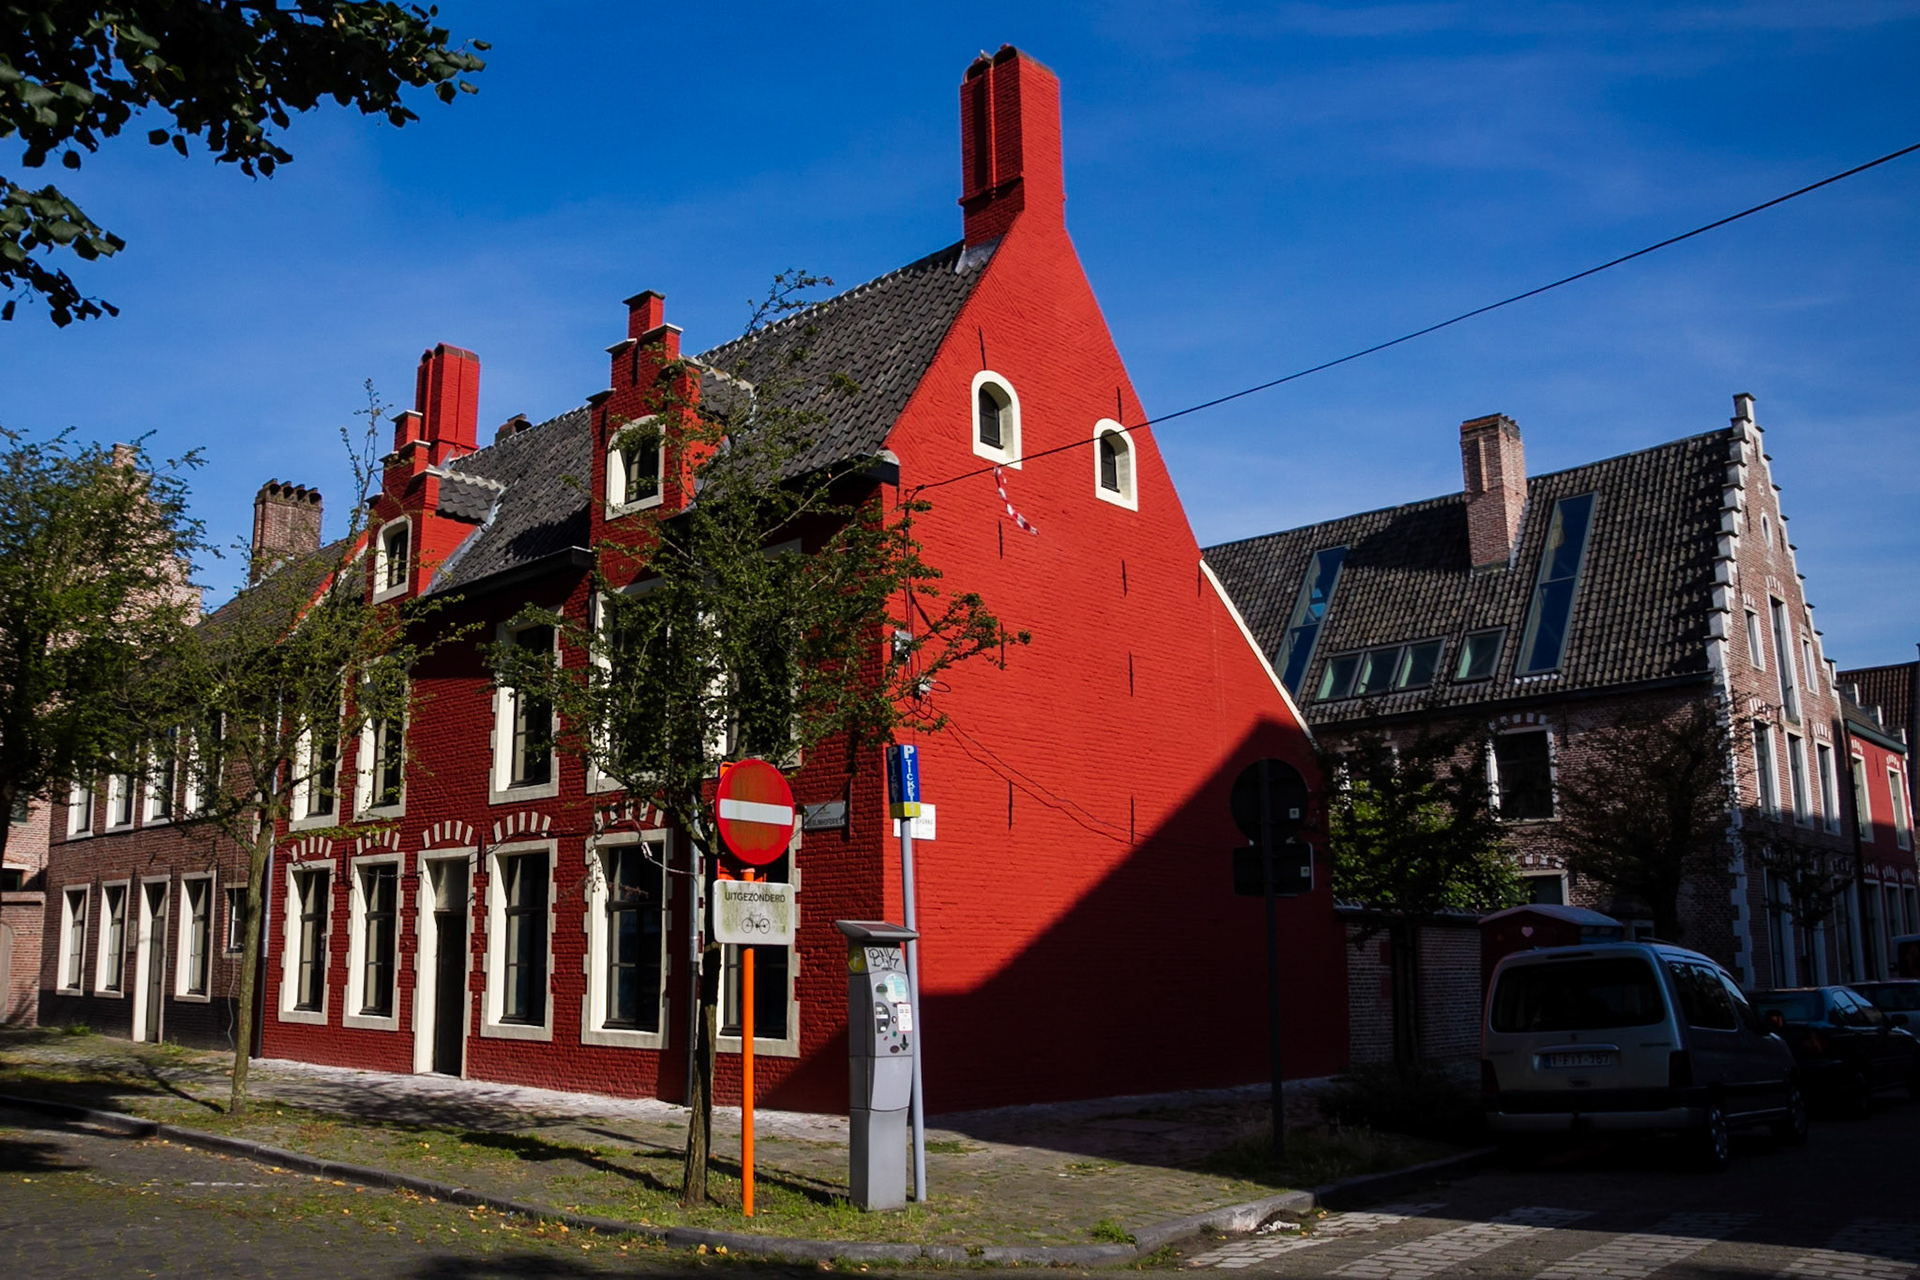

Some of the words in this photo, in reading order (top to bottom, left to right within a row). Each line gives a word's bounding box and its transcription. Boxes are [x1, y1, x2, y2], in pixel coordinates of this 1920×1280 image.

[903, 745, 914, 759] P
[905, 760, 916, 803] TICKET
[725, 892, 786, 903] UITGEZONDERD
